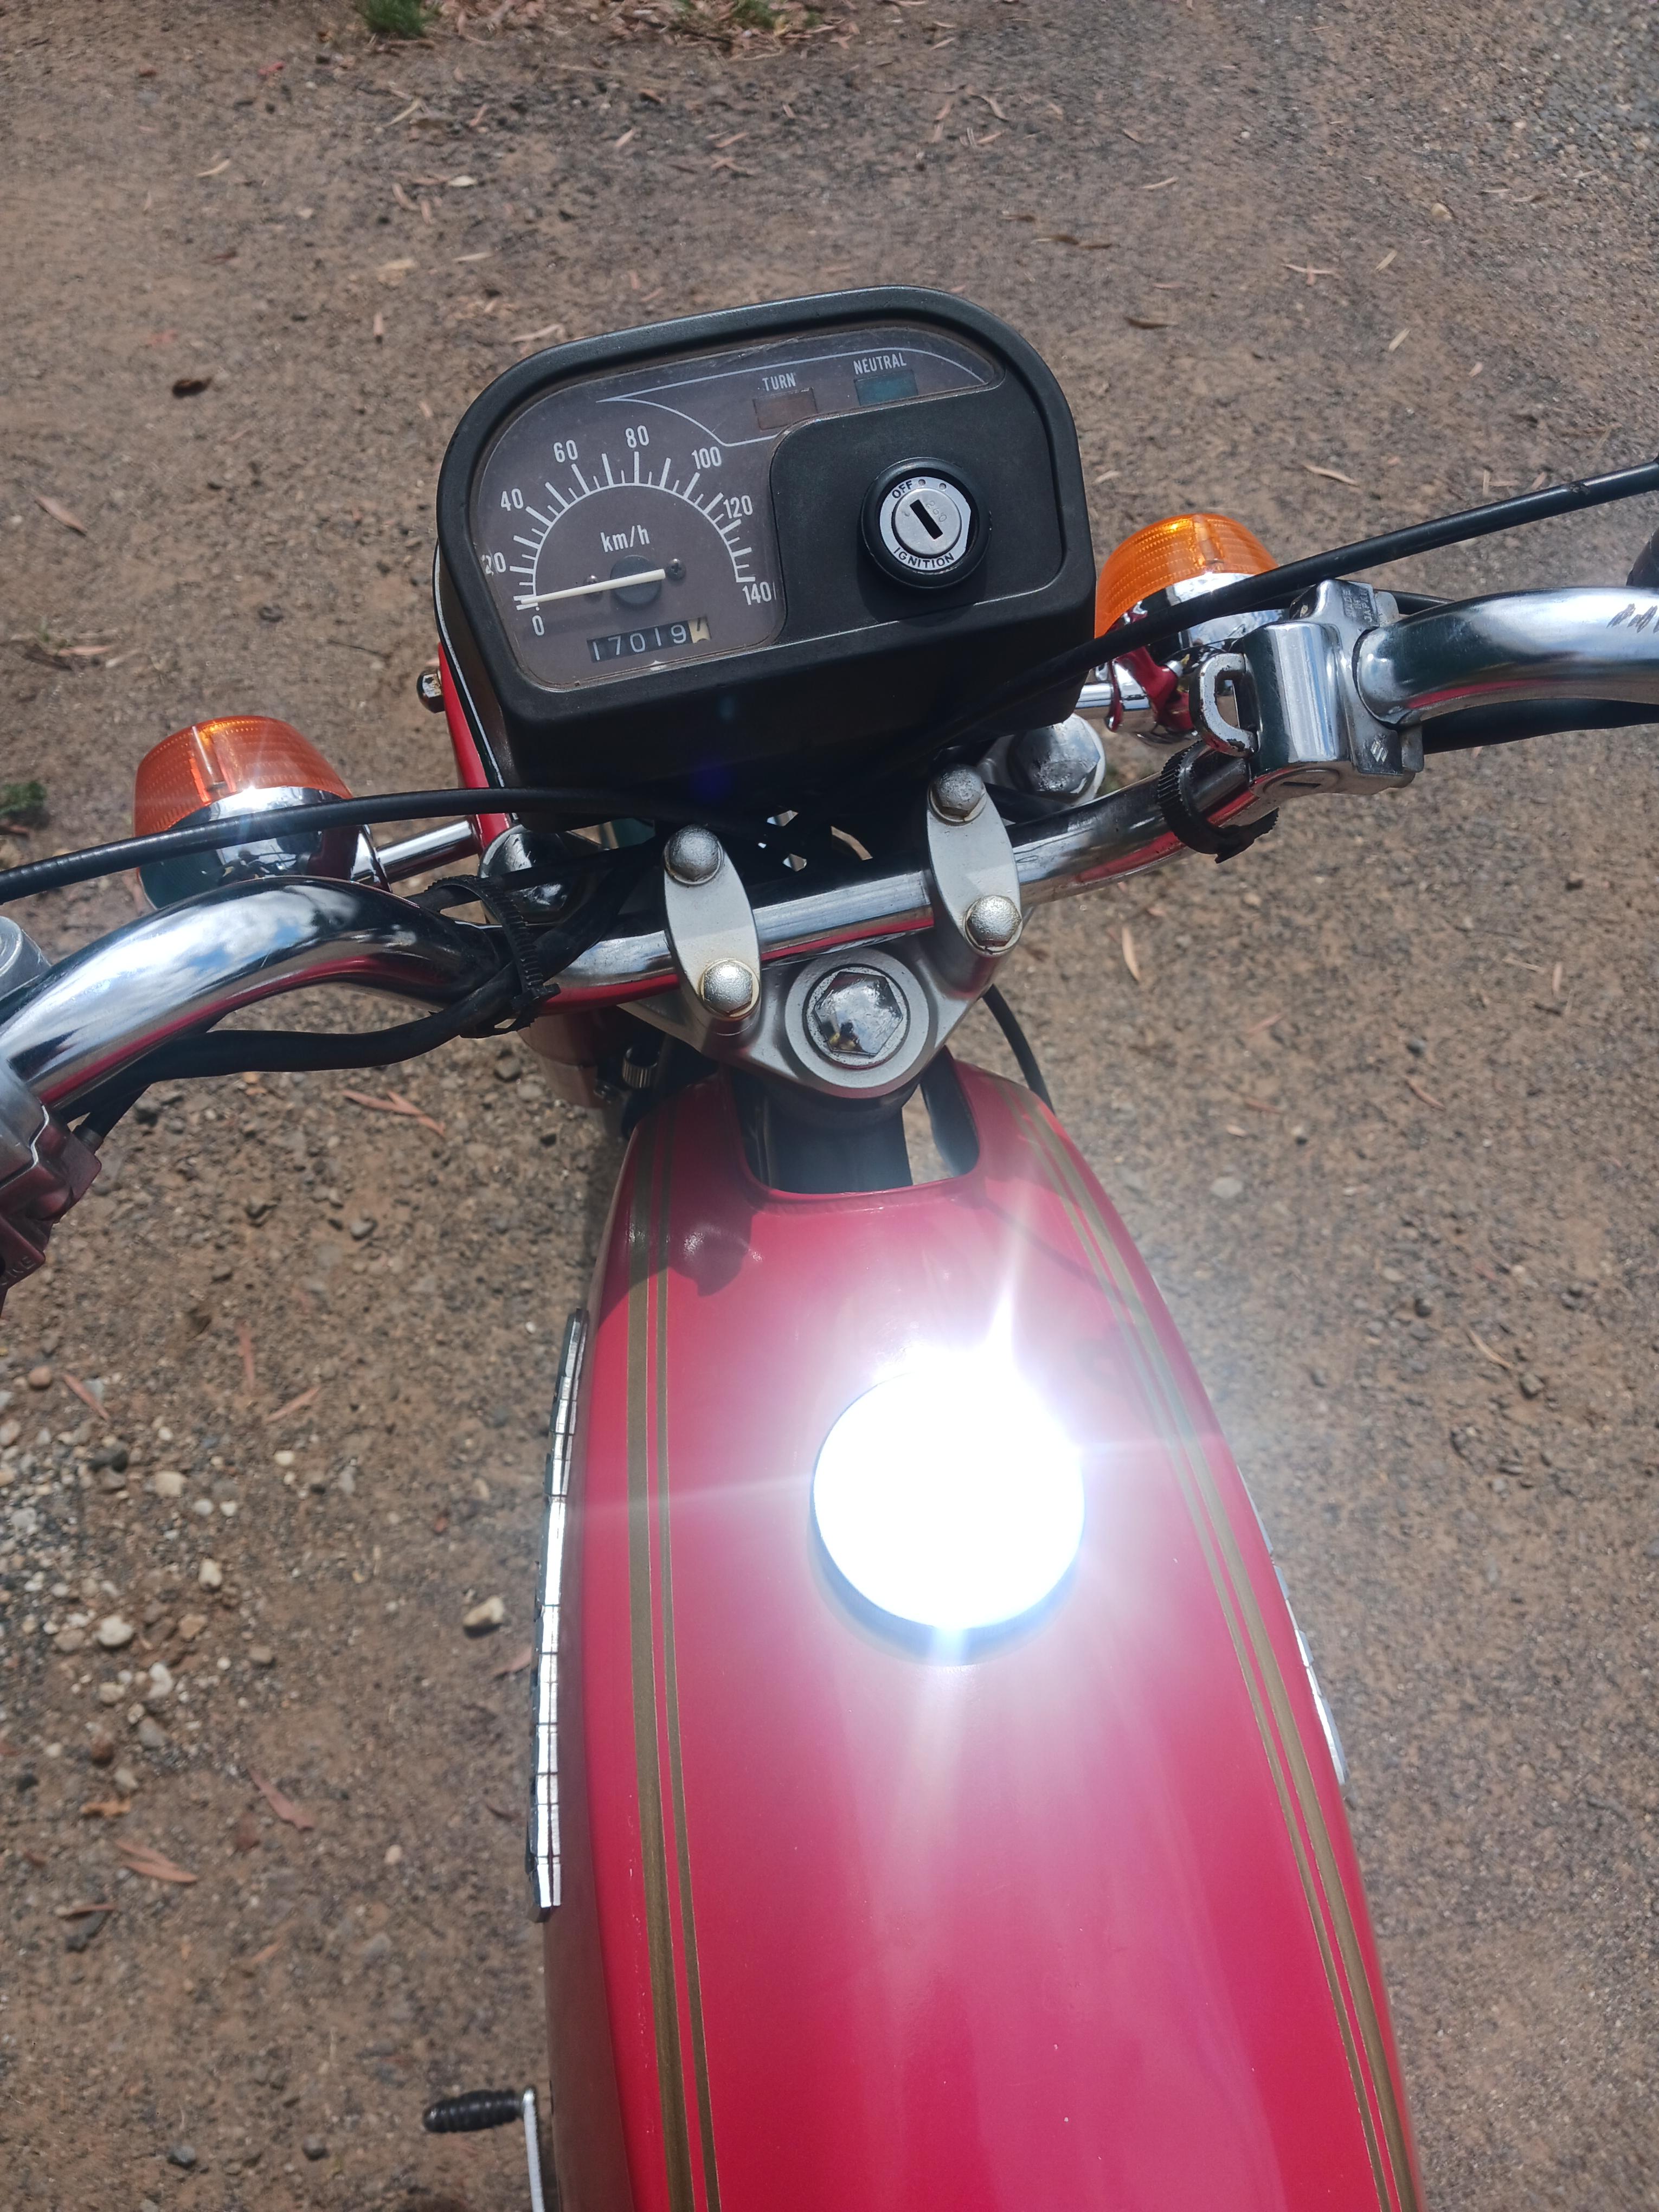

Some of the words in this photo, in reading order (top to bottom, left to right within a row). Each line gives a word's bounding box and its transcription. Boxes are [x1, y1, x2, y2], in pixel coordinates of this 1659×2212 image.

[853, 352, 907, 375] NEUTRAL
[762, 372, 796, 391] TURN
[625, 425, 650, 448] 80
[553, 440, 578, 463] 60
[691, 446, 722, 470] 100
[500, 488, 524, 511] 40
[892, 480, 912, 499] OFF
[723, 495, 753, 519] 120
[600, 524, 651, 552] km/h
[480, 552, 506, 576] 20
[893, 547, 955, 568] IGNITION
[742, 581, 772, 606] 140
[532, 615, 545, 636] 0
